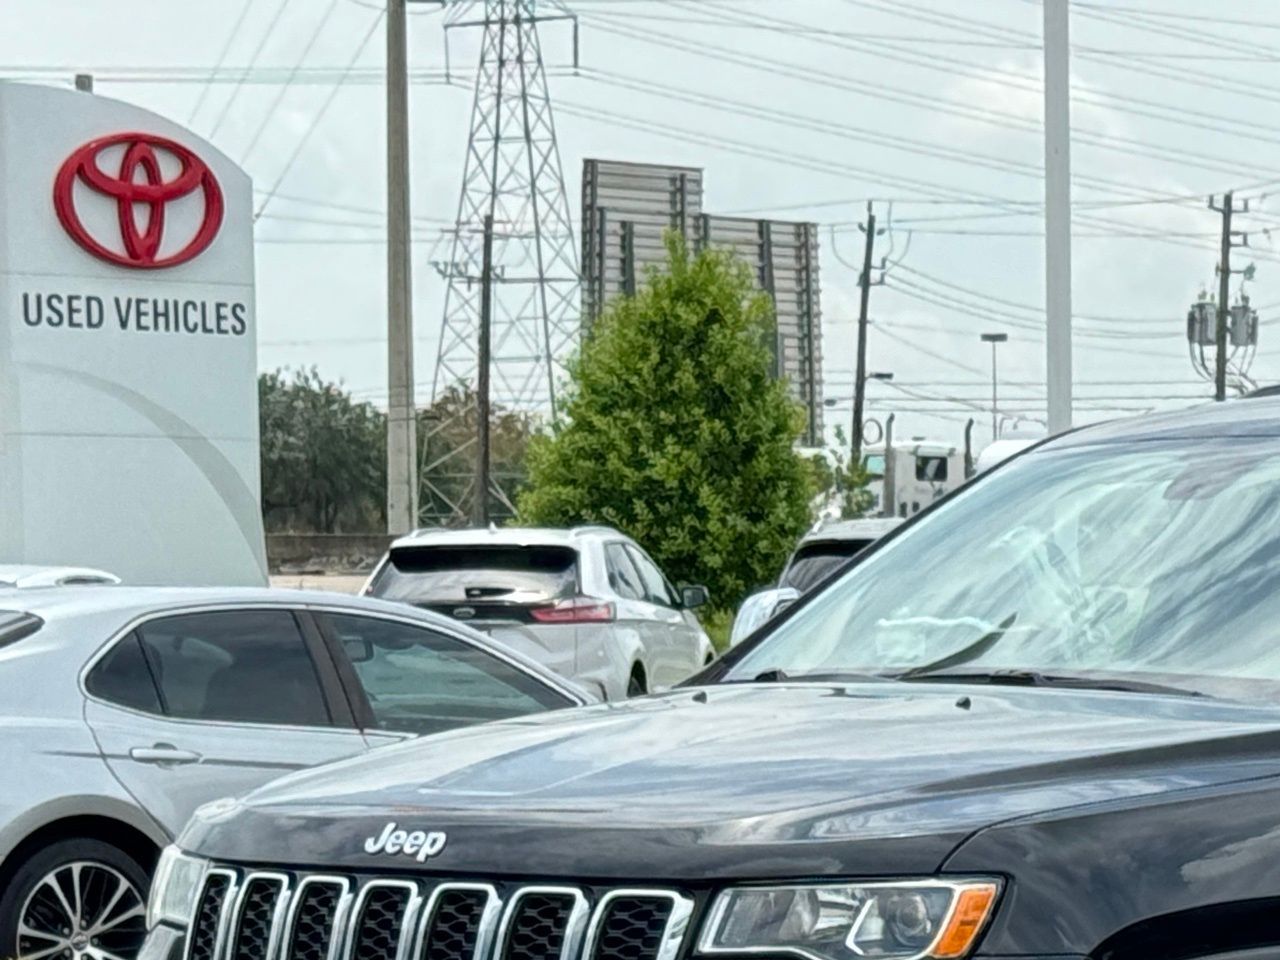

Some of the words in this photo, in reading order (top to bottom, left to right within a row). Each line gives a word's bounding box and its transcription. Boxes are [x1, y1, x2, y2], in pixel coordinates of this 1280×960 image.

[22, 293, 104, 329] USED
[115, 296, 247, 335] VEHICLES
[364, 822, 447, 862] Jeep
